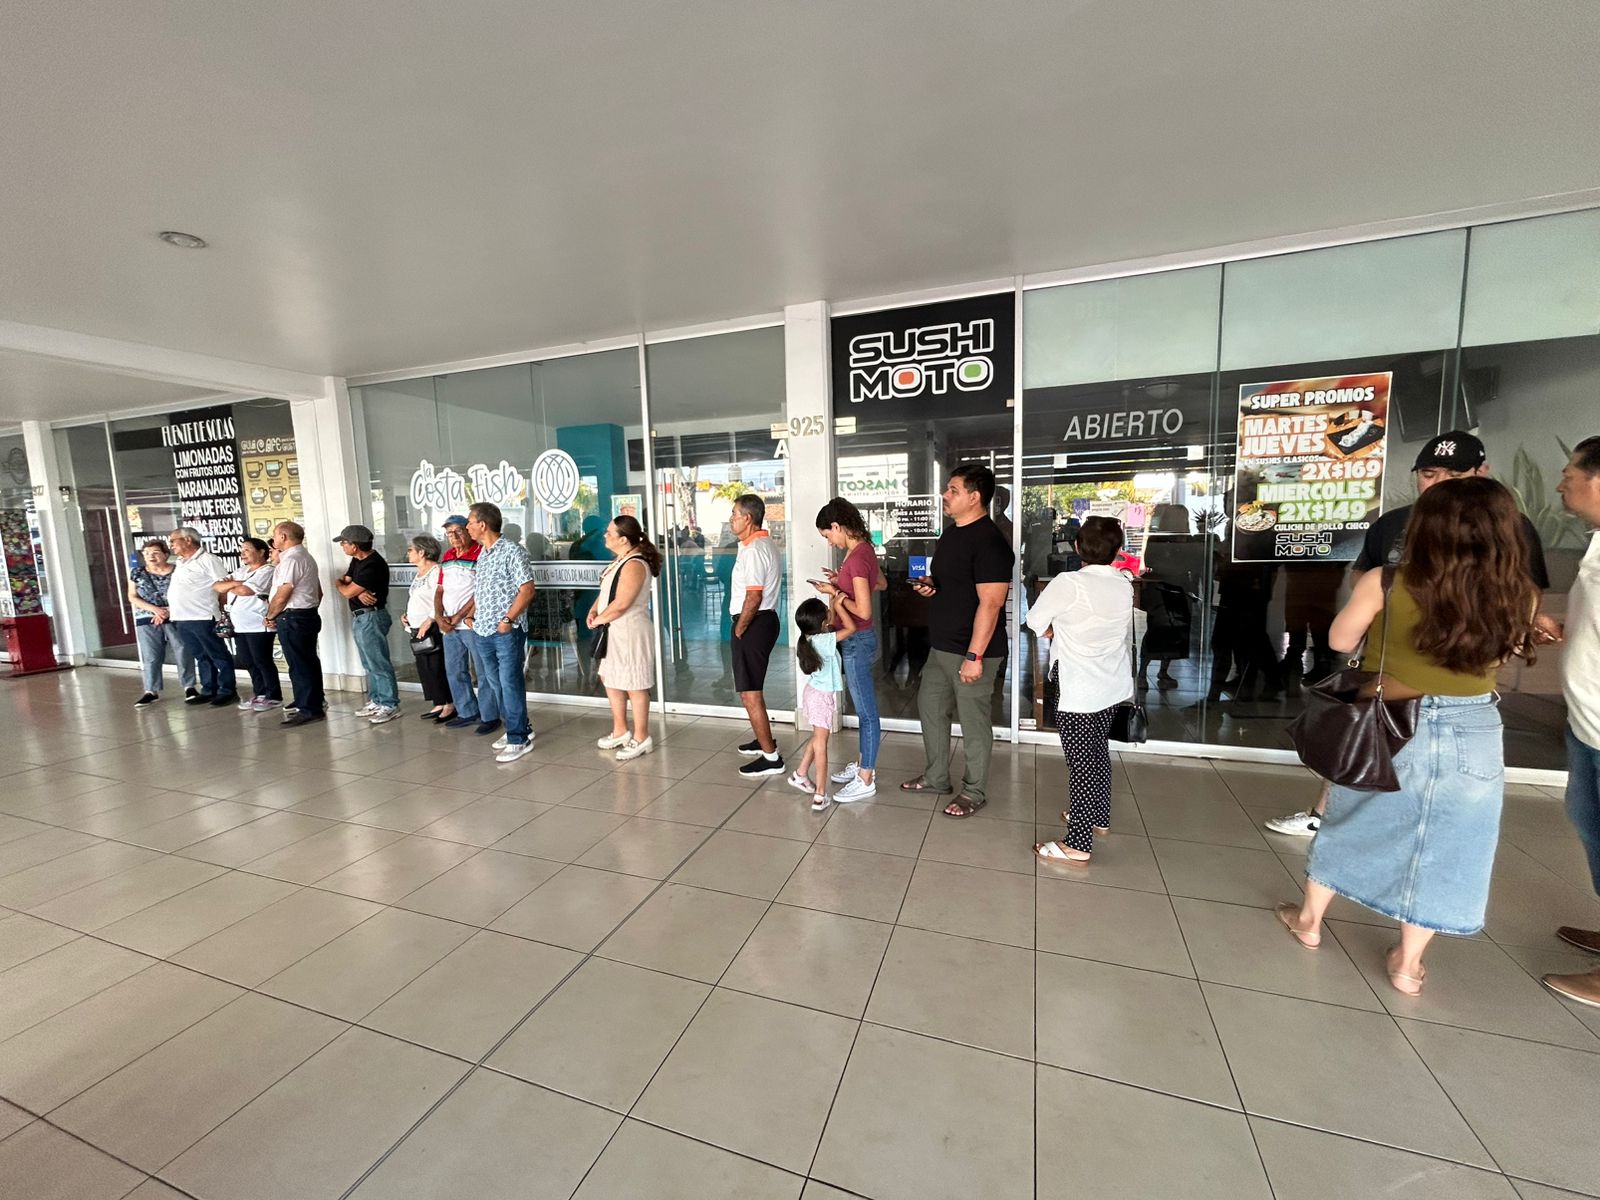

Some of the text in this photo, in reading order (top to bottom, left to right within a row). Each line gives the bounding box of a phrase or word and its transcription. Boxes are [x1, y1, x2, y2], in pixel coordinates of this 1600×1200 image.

[849, 318, 994, 368] SUSHI
[850, 355, 993, 403] MOTO
[1251, 387, 1375, 410] SUPER PROMOS
[161, 416, 235, 447] FUENTE DE SODAS
[790, 415, 824, 437] 925
[1063, 408, 1183, 441] ABIERTO
[1244, 414, 1328, 436] MARTES
[1242, 433, 1326, 456] JUEVES
[173, 445, 234, 468] LIMONADAS
[1255, 457, 1282, 465] SUSHIS
[1283, 455, 1319, 464] CLASICOS
[175, 464, 236, 479] CON FRUTOS ROJOS
[1302, 459, 1381, 480] 2X$169
[177, 477, 239, 499] NARANJADAS
[412, 464, 522, 512] Costa Fish
[1258, 480, 1376, 501] MIERCOLES
[181, 497, 242, 518] AGUA DE FRESA
[895, 499, 932, 507] HORARIO
[1279, 501, 1367, 522] 2X$149
[208, 517, 244, 537] FRESCAS
[1274, 523, 1304, 531] CULICHI
[1318, 522, 1343, 530] POLLO
[1345, 522, 1370, 530] CHICO
[1276, 532, 1333, 545] SUSHI
[1274, 544, 1332, 557] MOTO
